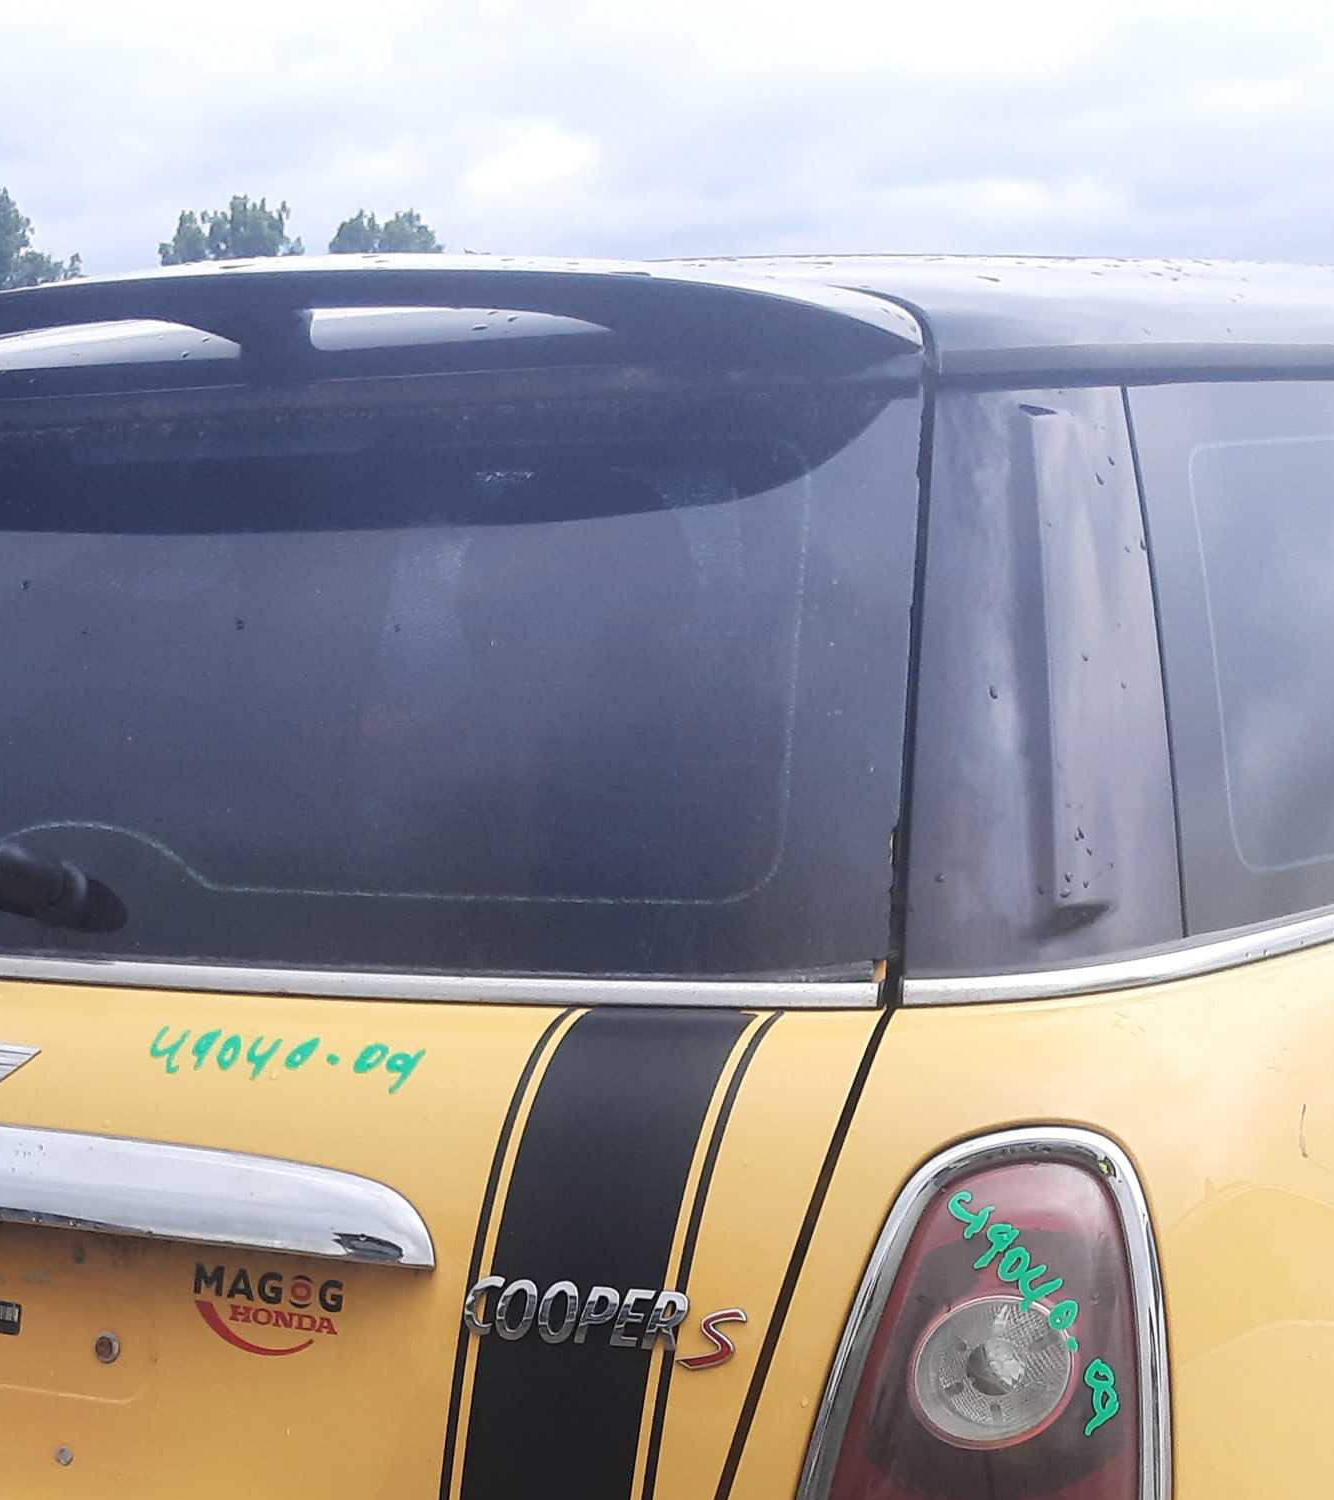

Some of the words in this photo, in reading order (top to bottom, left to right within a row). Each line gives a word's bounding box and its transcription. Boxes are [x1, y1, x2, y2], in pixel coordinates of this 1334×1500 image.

[193, 1263, 344, 1313] MAGOG
[229, 1304, 338, 1336] HONDA
[464, 1275, 689, 1352] COOPER
[675, 1308, 747, 1370] S
